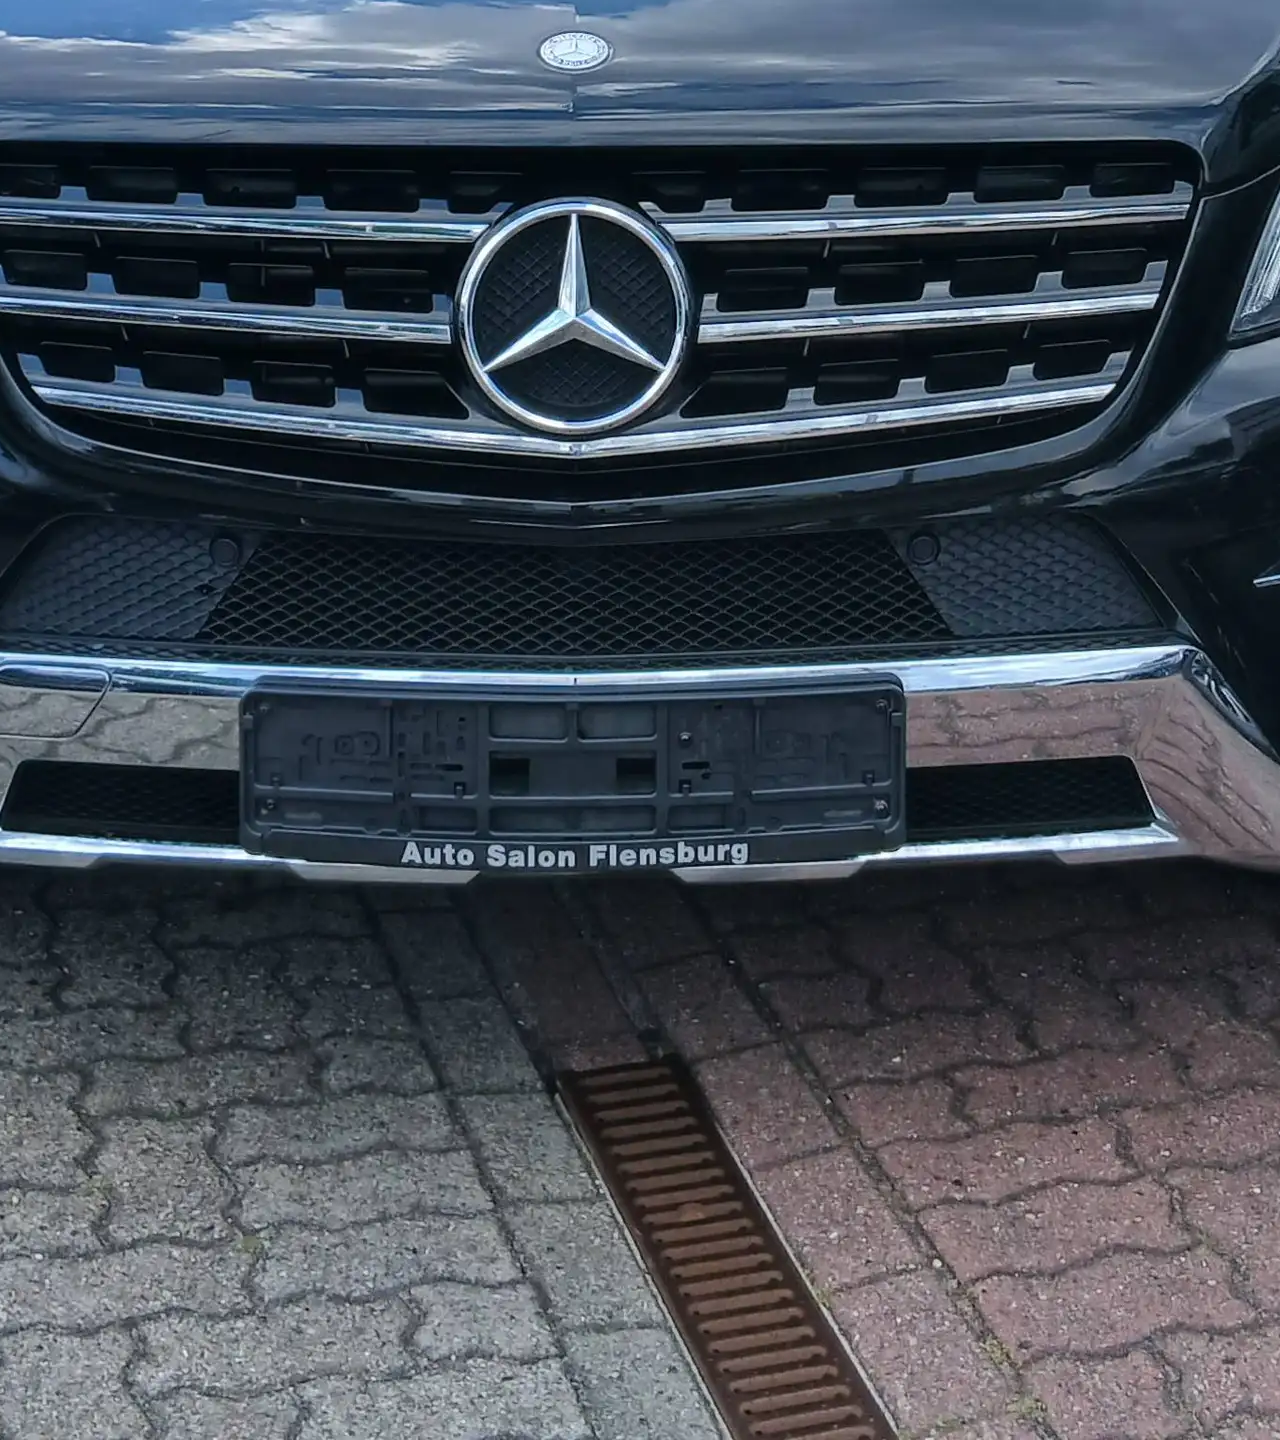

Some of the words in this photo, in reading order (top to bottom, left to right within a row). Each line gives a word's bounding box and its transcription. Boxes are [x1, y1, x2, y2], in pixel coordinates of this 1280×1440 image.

[401, 841, 474, 866] Auto
[488, 845, 576, 868] Salon
[588, 840, 749, 868] Flensburg
